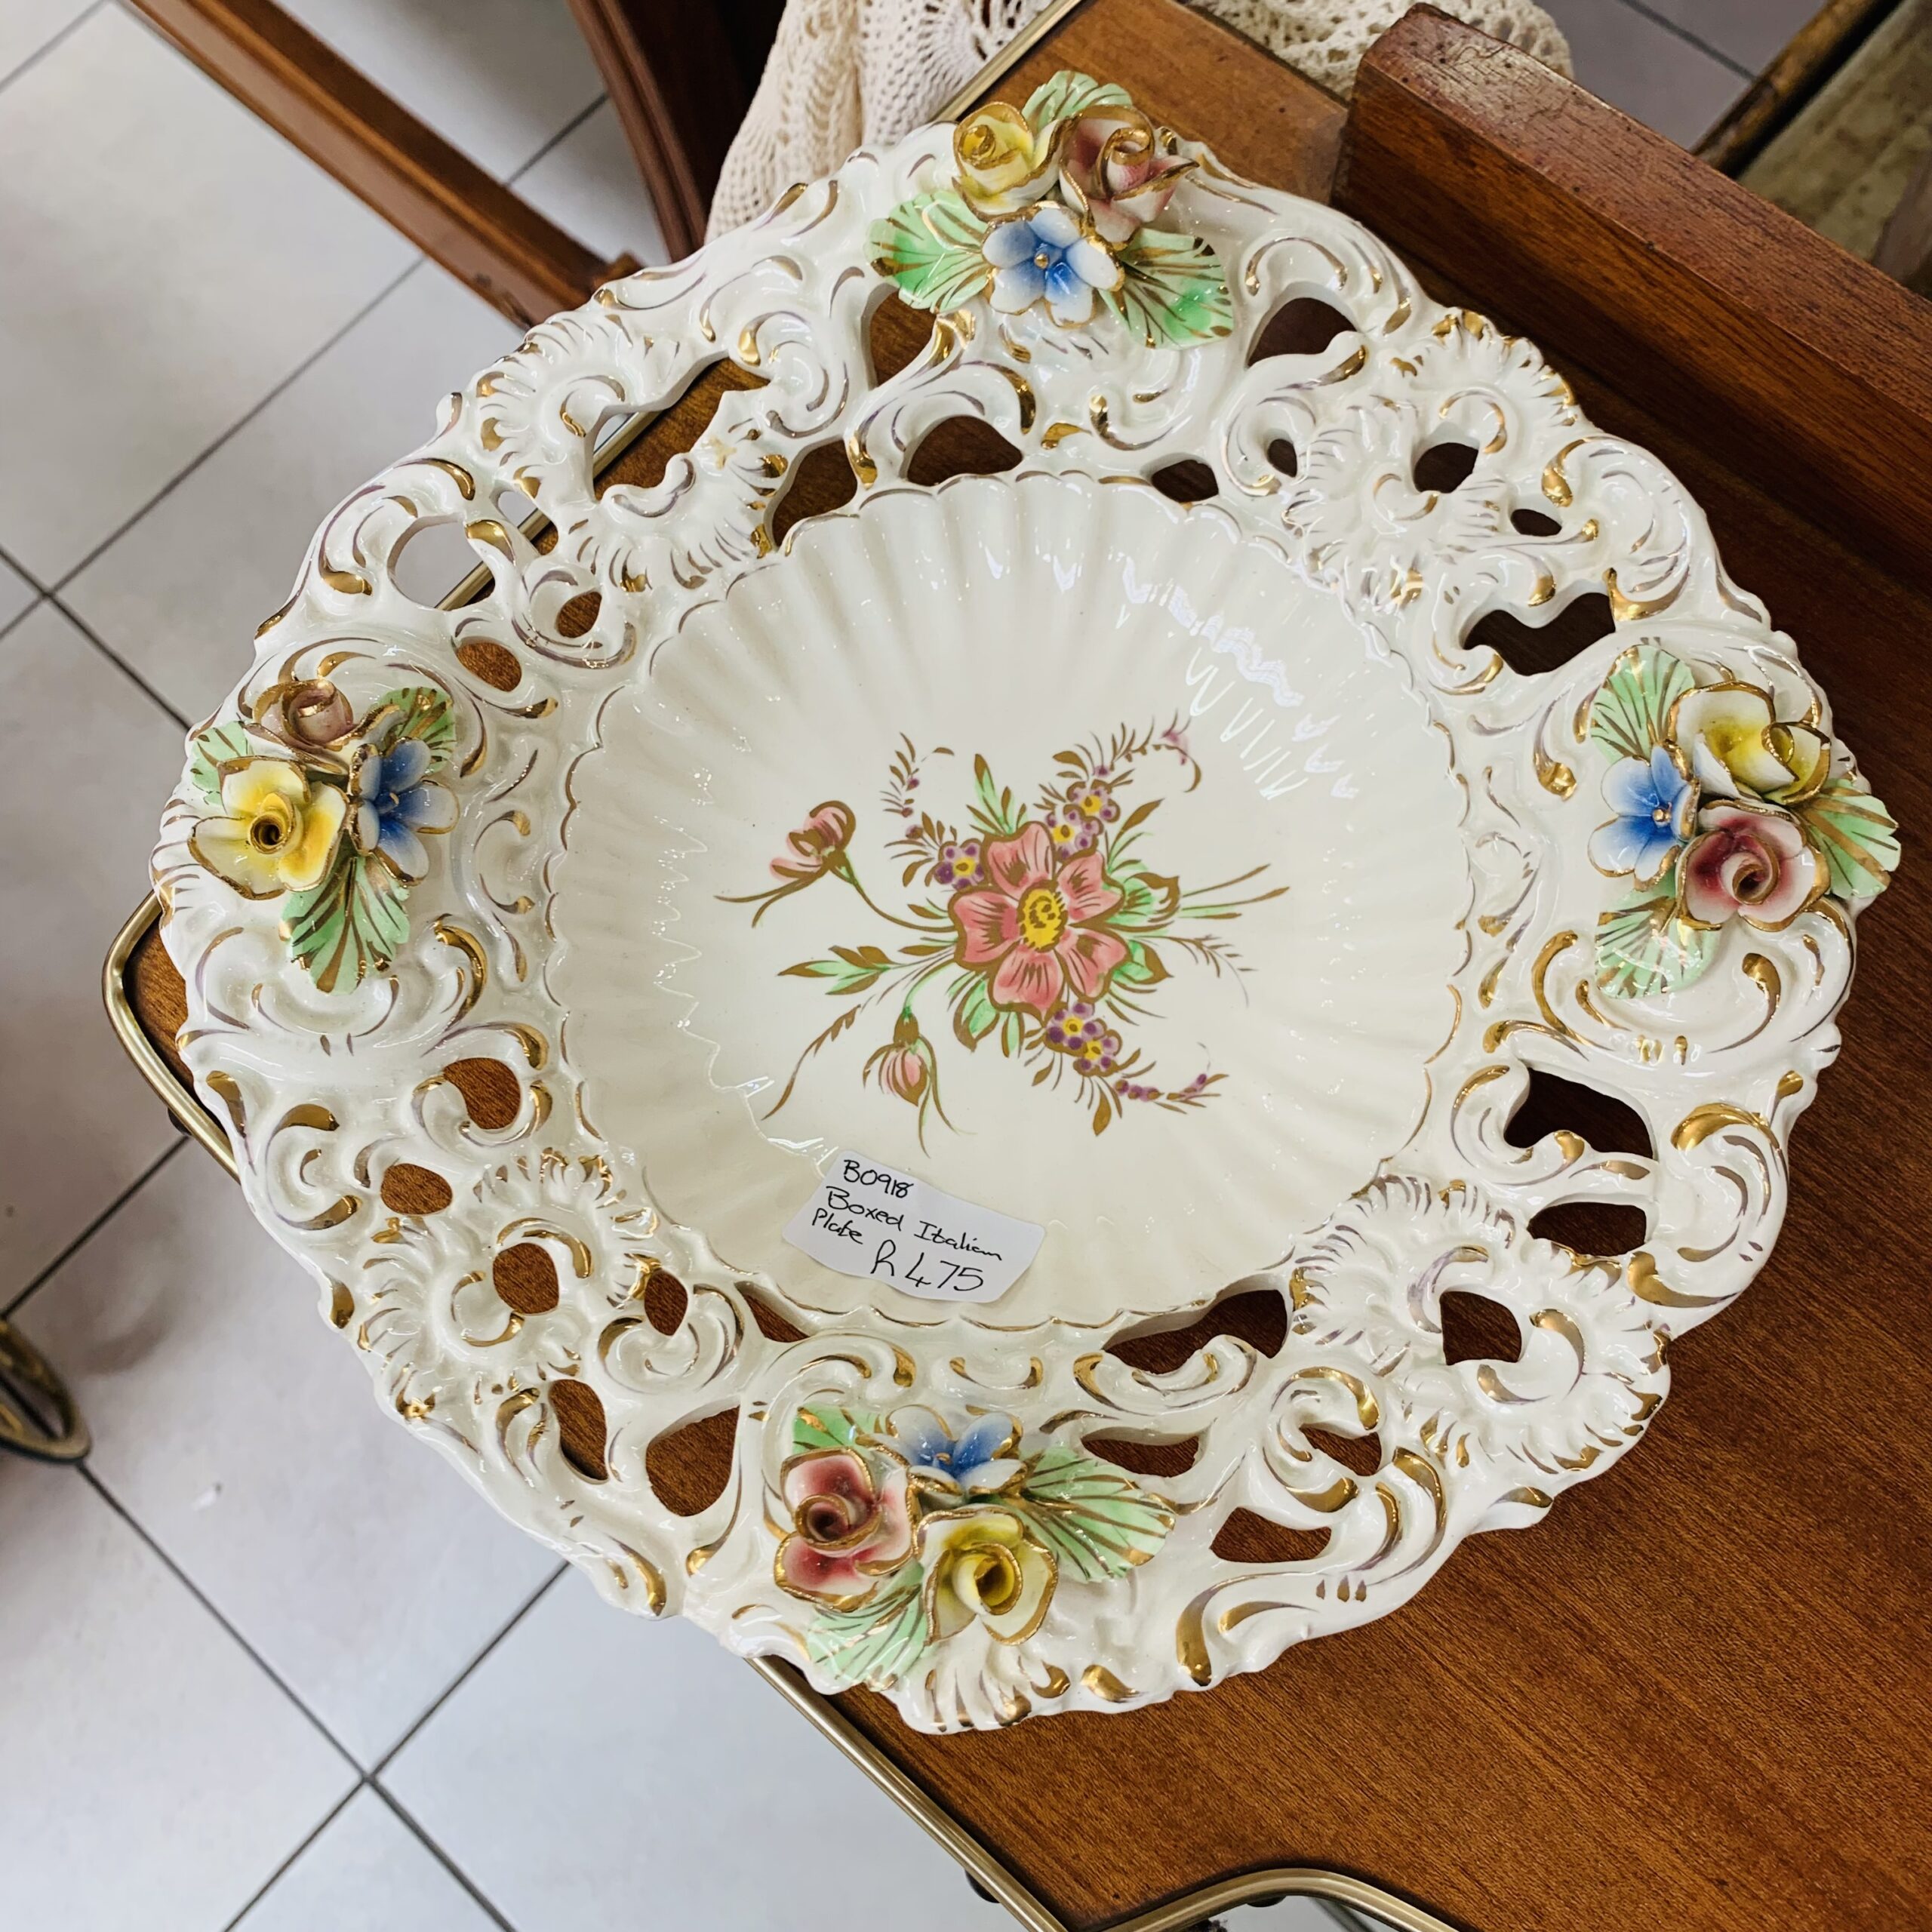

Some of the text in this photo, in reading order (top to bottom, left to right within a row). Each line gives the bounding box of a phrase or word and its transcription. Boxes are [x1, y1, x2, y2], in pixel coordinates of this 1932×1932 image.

[811, 1208, 863, 1244] Plate
[826, 1186, 1002, 1261] Boxed Italian
